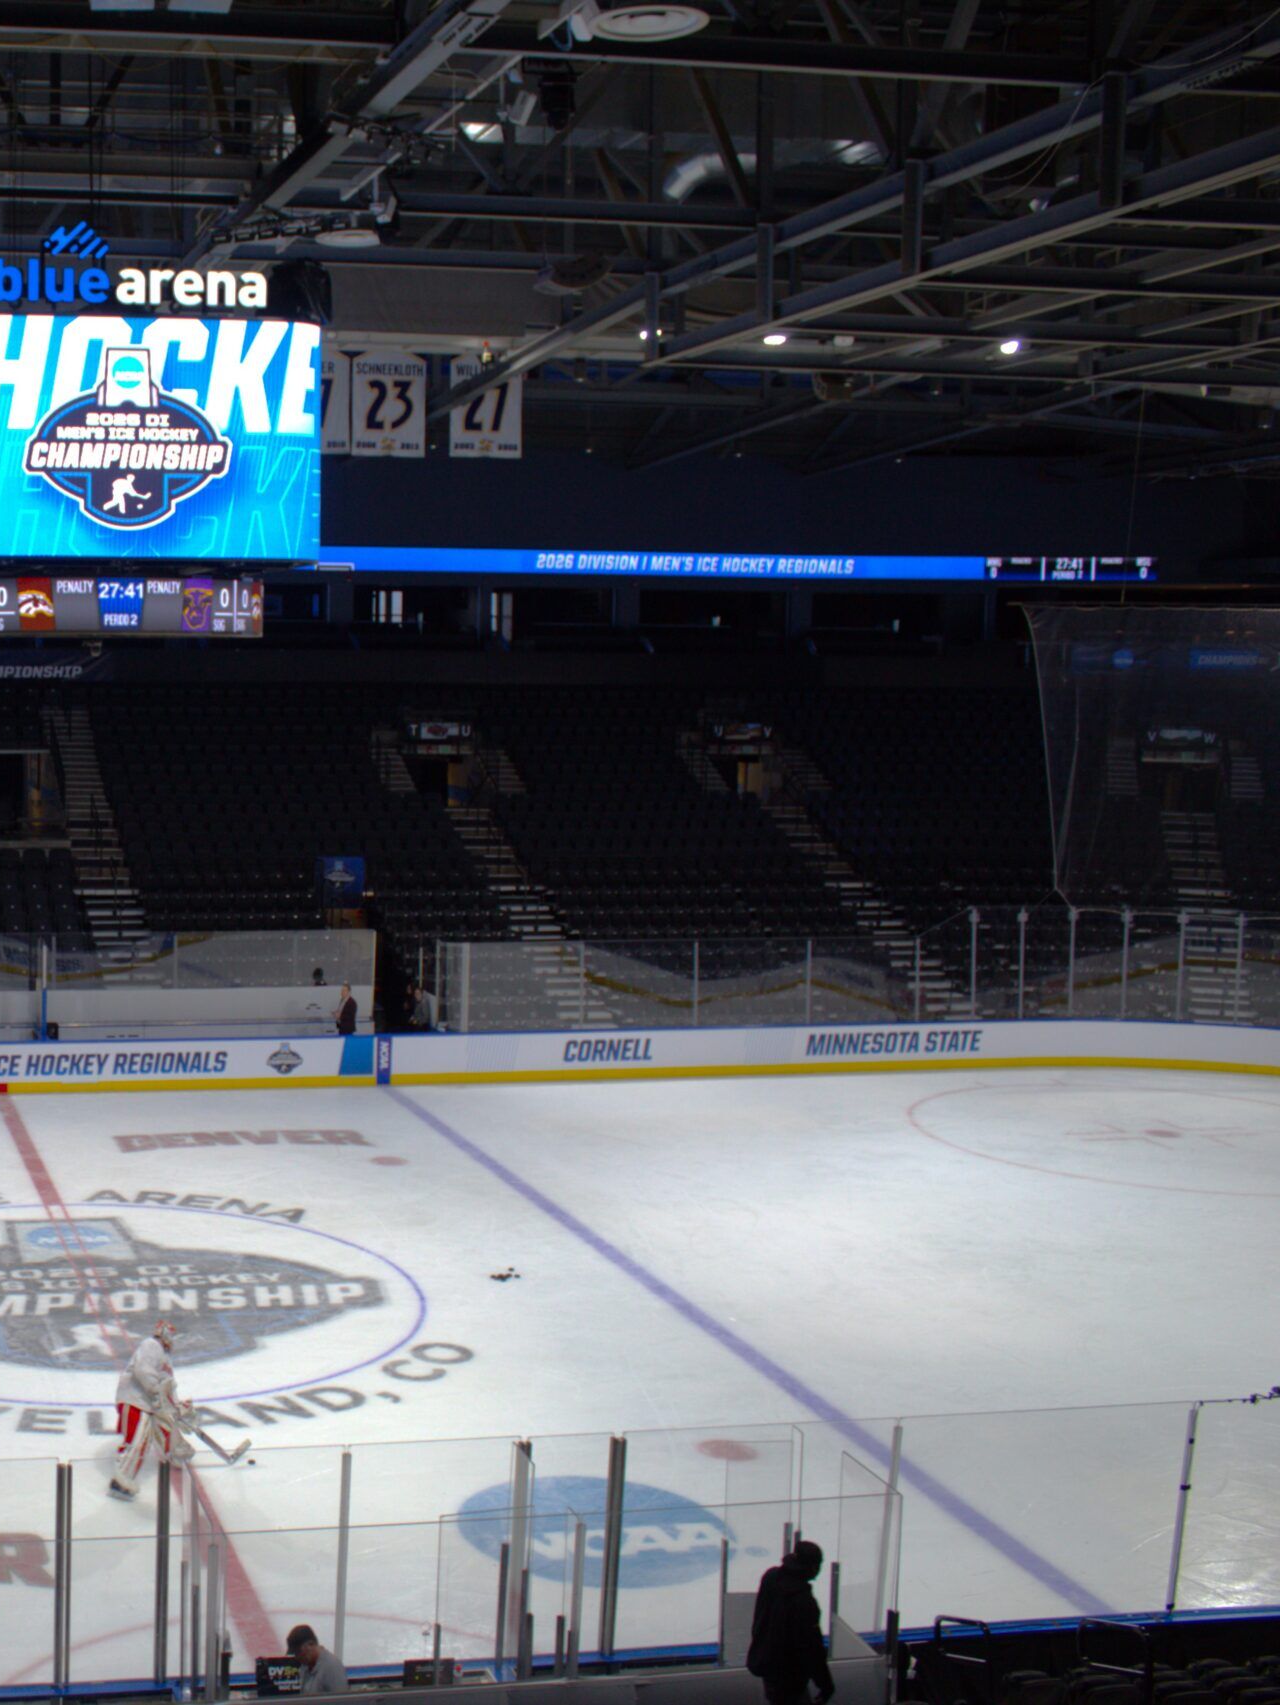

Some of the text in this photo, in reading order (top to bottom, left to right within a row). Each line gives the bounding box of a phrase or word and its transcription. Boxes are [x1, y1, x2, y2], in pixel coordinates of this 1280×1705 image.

[116, 268, 268, 308] arena
[356, 362, 424, 377] SCHNEEKLOTH
[366, 380, 414, 430] 23
[85, 412, 170, 427] 2026 DI
[56, 427, 200, 441] MEN'S ICE HOCKEY
[29, 442, 224, 471] CHAMPIONSHIP
[536, 553, 574, 569] 2026
[577, 554, 639, 571] DIVISION
[650, 555, 694, 572] MEN'S
[697, 556, 718, 572] ICE
[721, 557, 773, 574] HOCKEY
[777, 558, 855, 575] REGIONALS
[56, 580, 95, 595] PENALTY
[98, 582, 144, 599] 27:41
[146, 580, 181, 594] PENALTY
[130, 613, 138, 625] 2
[562, 1038, 653, 1063] CORNELL
[806, 1030, 983, 1057] MINNESOTA STATE
[24, 1052, 109, 1076] HOCKEY
[111, 1051, 229, 1075] REGIONALS
[113, 1129, 376, 1154] DENVER
[84, 1189, 308, 1224] ARENA
[121, 1273, 282, 1288] HOCKEY
